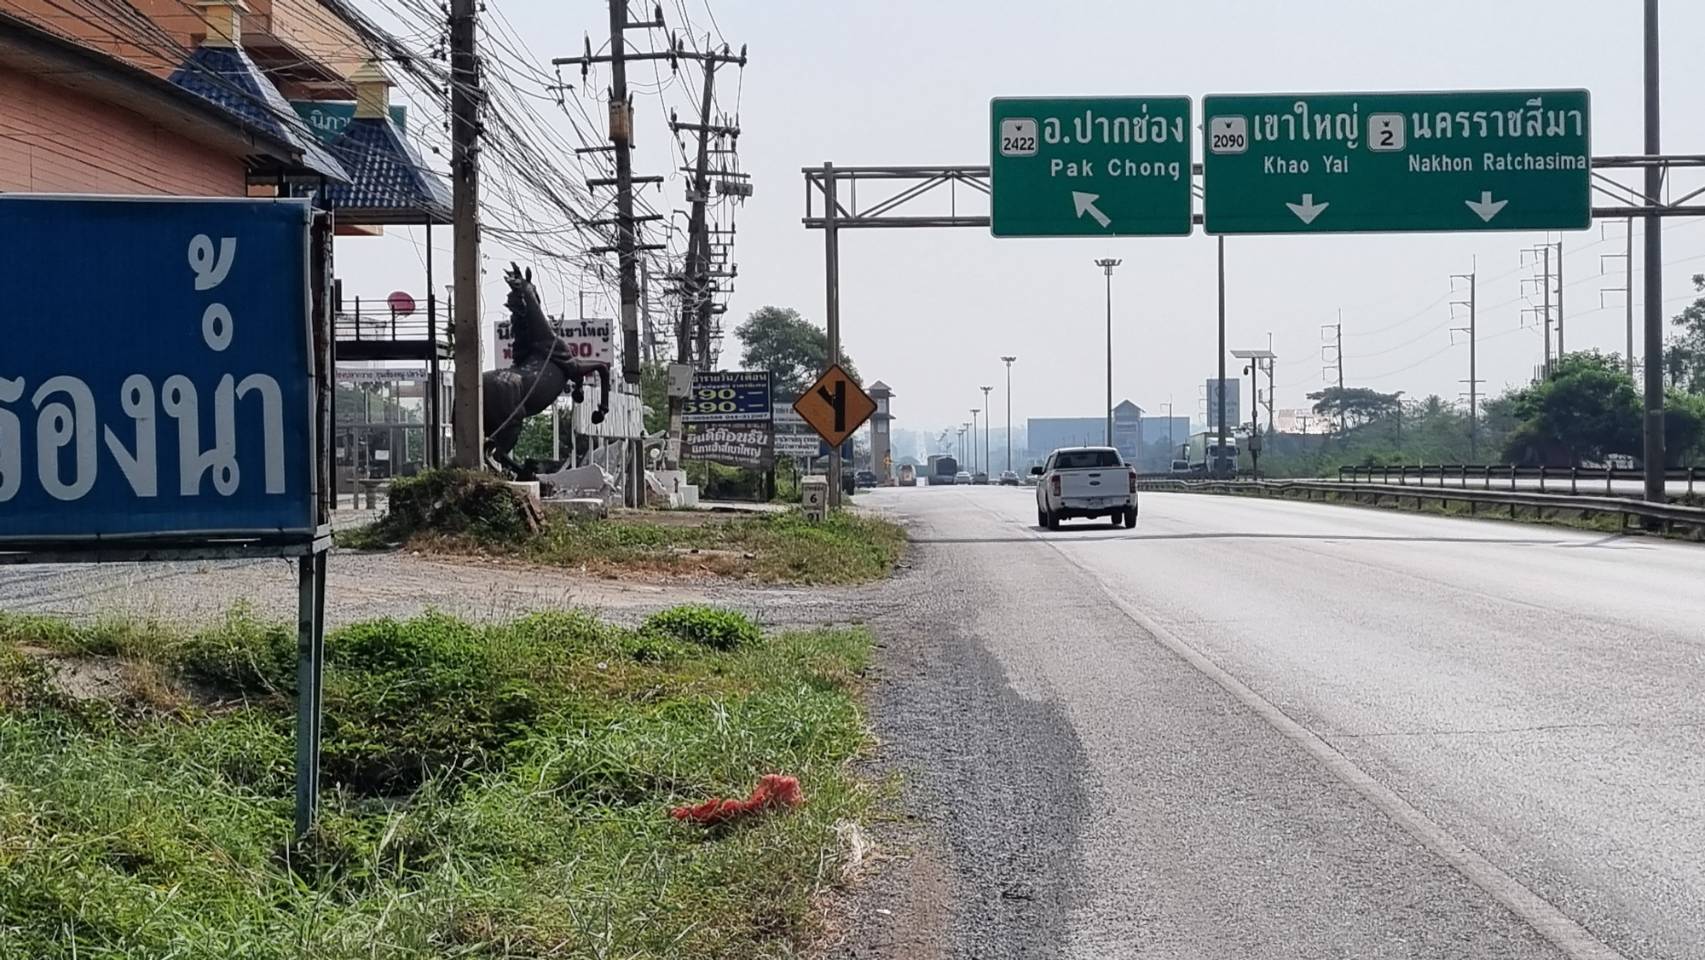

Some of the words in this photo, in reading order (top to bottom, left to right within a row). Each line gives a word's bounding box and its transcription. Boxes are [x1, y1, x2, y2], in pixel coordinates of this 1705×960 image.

[1003, 137, 1035, 151] 2422
[1043, 103, 1184, 144] อ.ปากช่อง
[1212, 134, 1245, 149] 2090
[1253, 101, 1359, 149] เขาใหญ่
[1380, 130, 1394, 146] 2
[1412, 97, 1584, 139] นครราชสีมา
[1051, 159, 1094, 177] Pak
[1107, 158, 1181, 181] Chong
[1263, 155, 1309, 174] Khao
[1322, 154, 1349, 173] Yai
[1408, 153, 1473, 173] Nakhon
[1483, 152, 1587, 172] Ratchasima
[810, 493, 818, 504] 6
